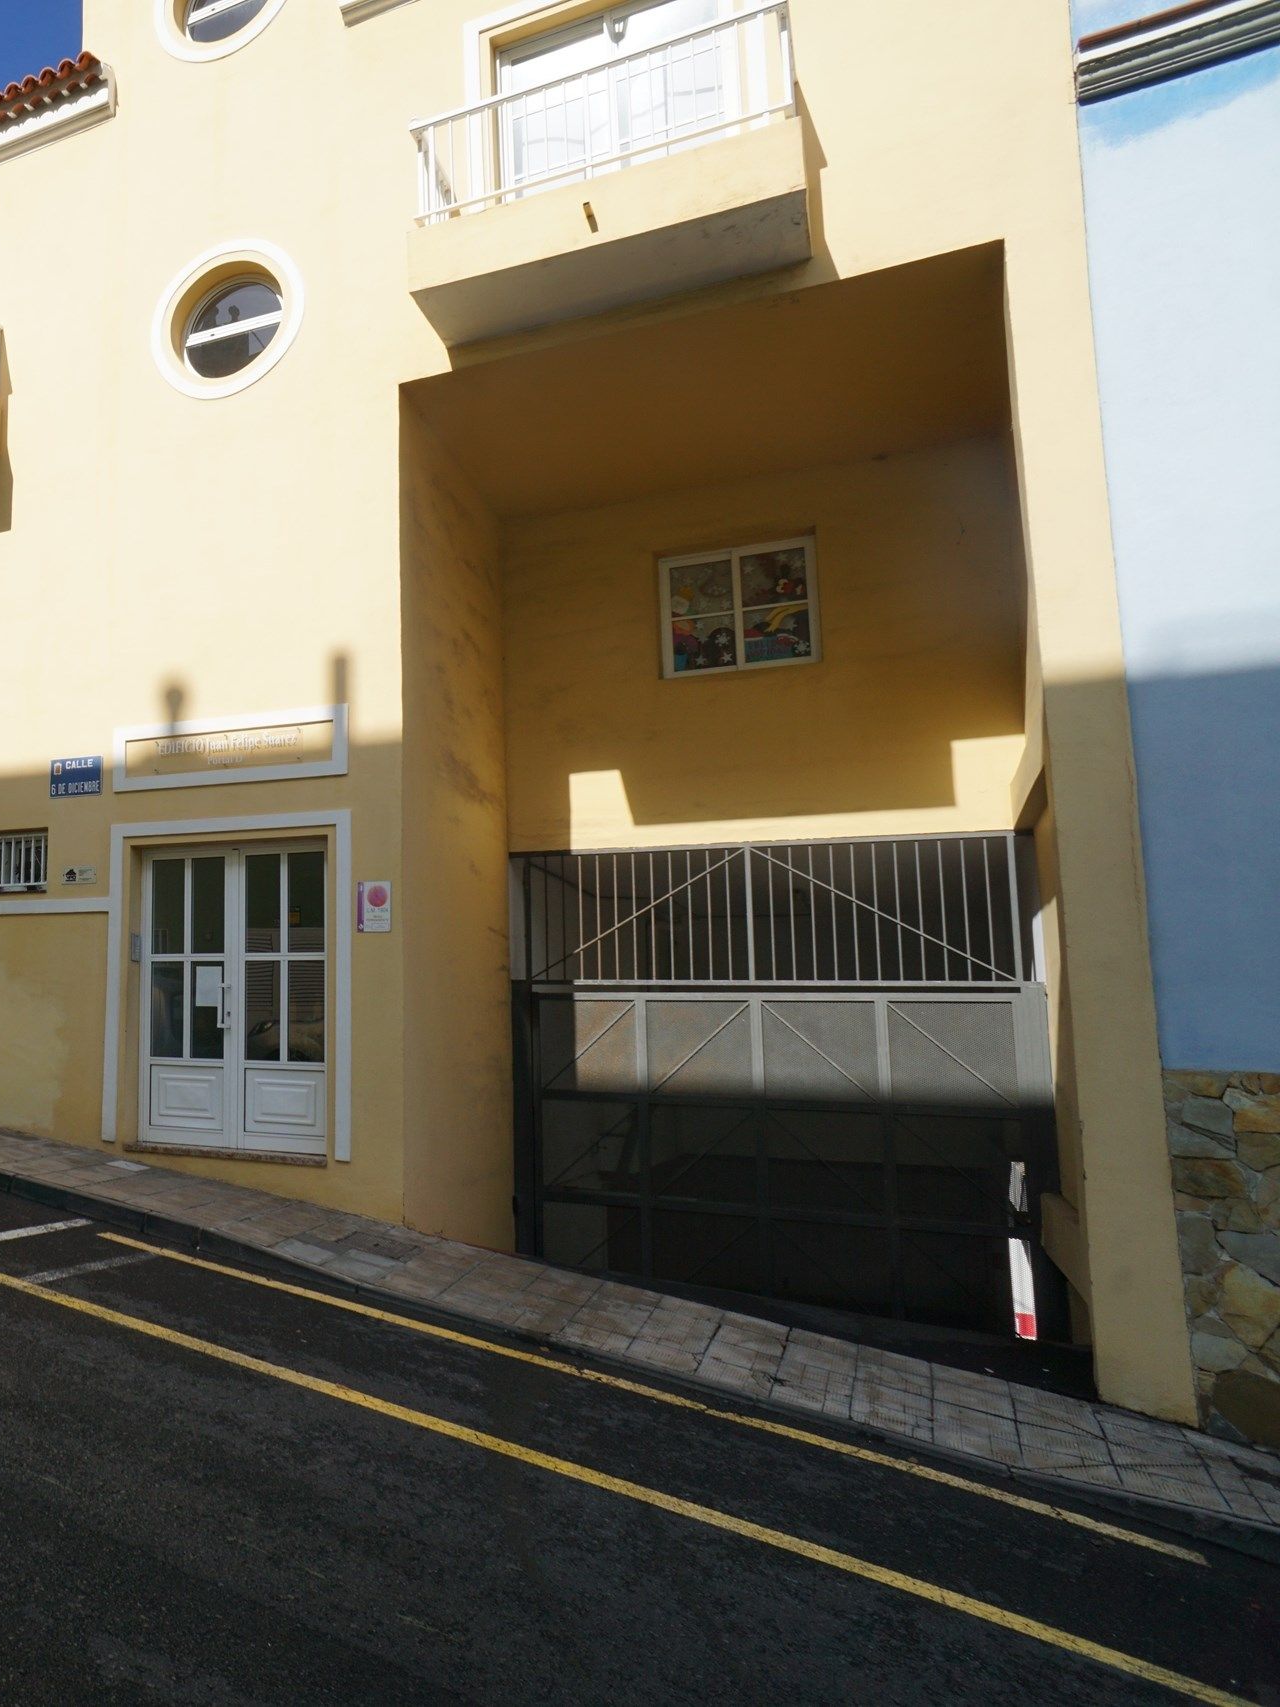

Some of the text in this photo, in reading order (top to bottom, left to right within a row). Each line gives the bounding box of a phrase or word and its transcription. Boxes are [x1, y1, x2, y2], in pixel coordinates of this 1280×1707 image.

[159, 739, 206, 756] EDIFICIO
[207, 737, 230, 755] Juan
[231, 733, 261, 752] Felipe
[65, 759, 94, 770] CALLE
[51, 780, 100, 795] 6 DE DICIEMBRE
